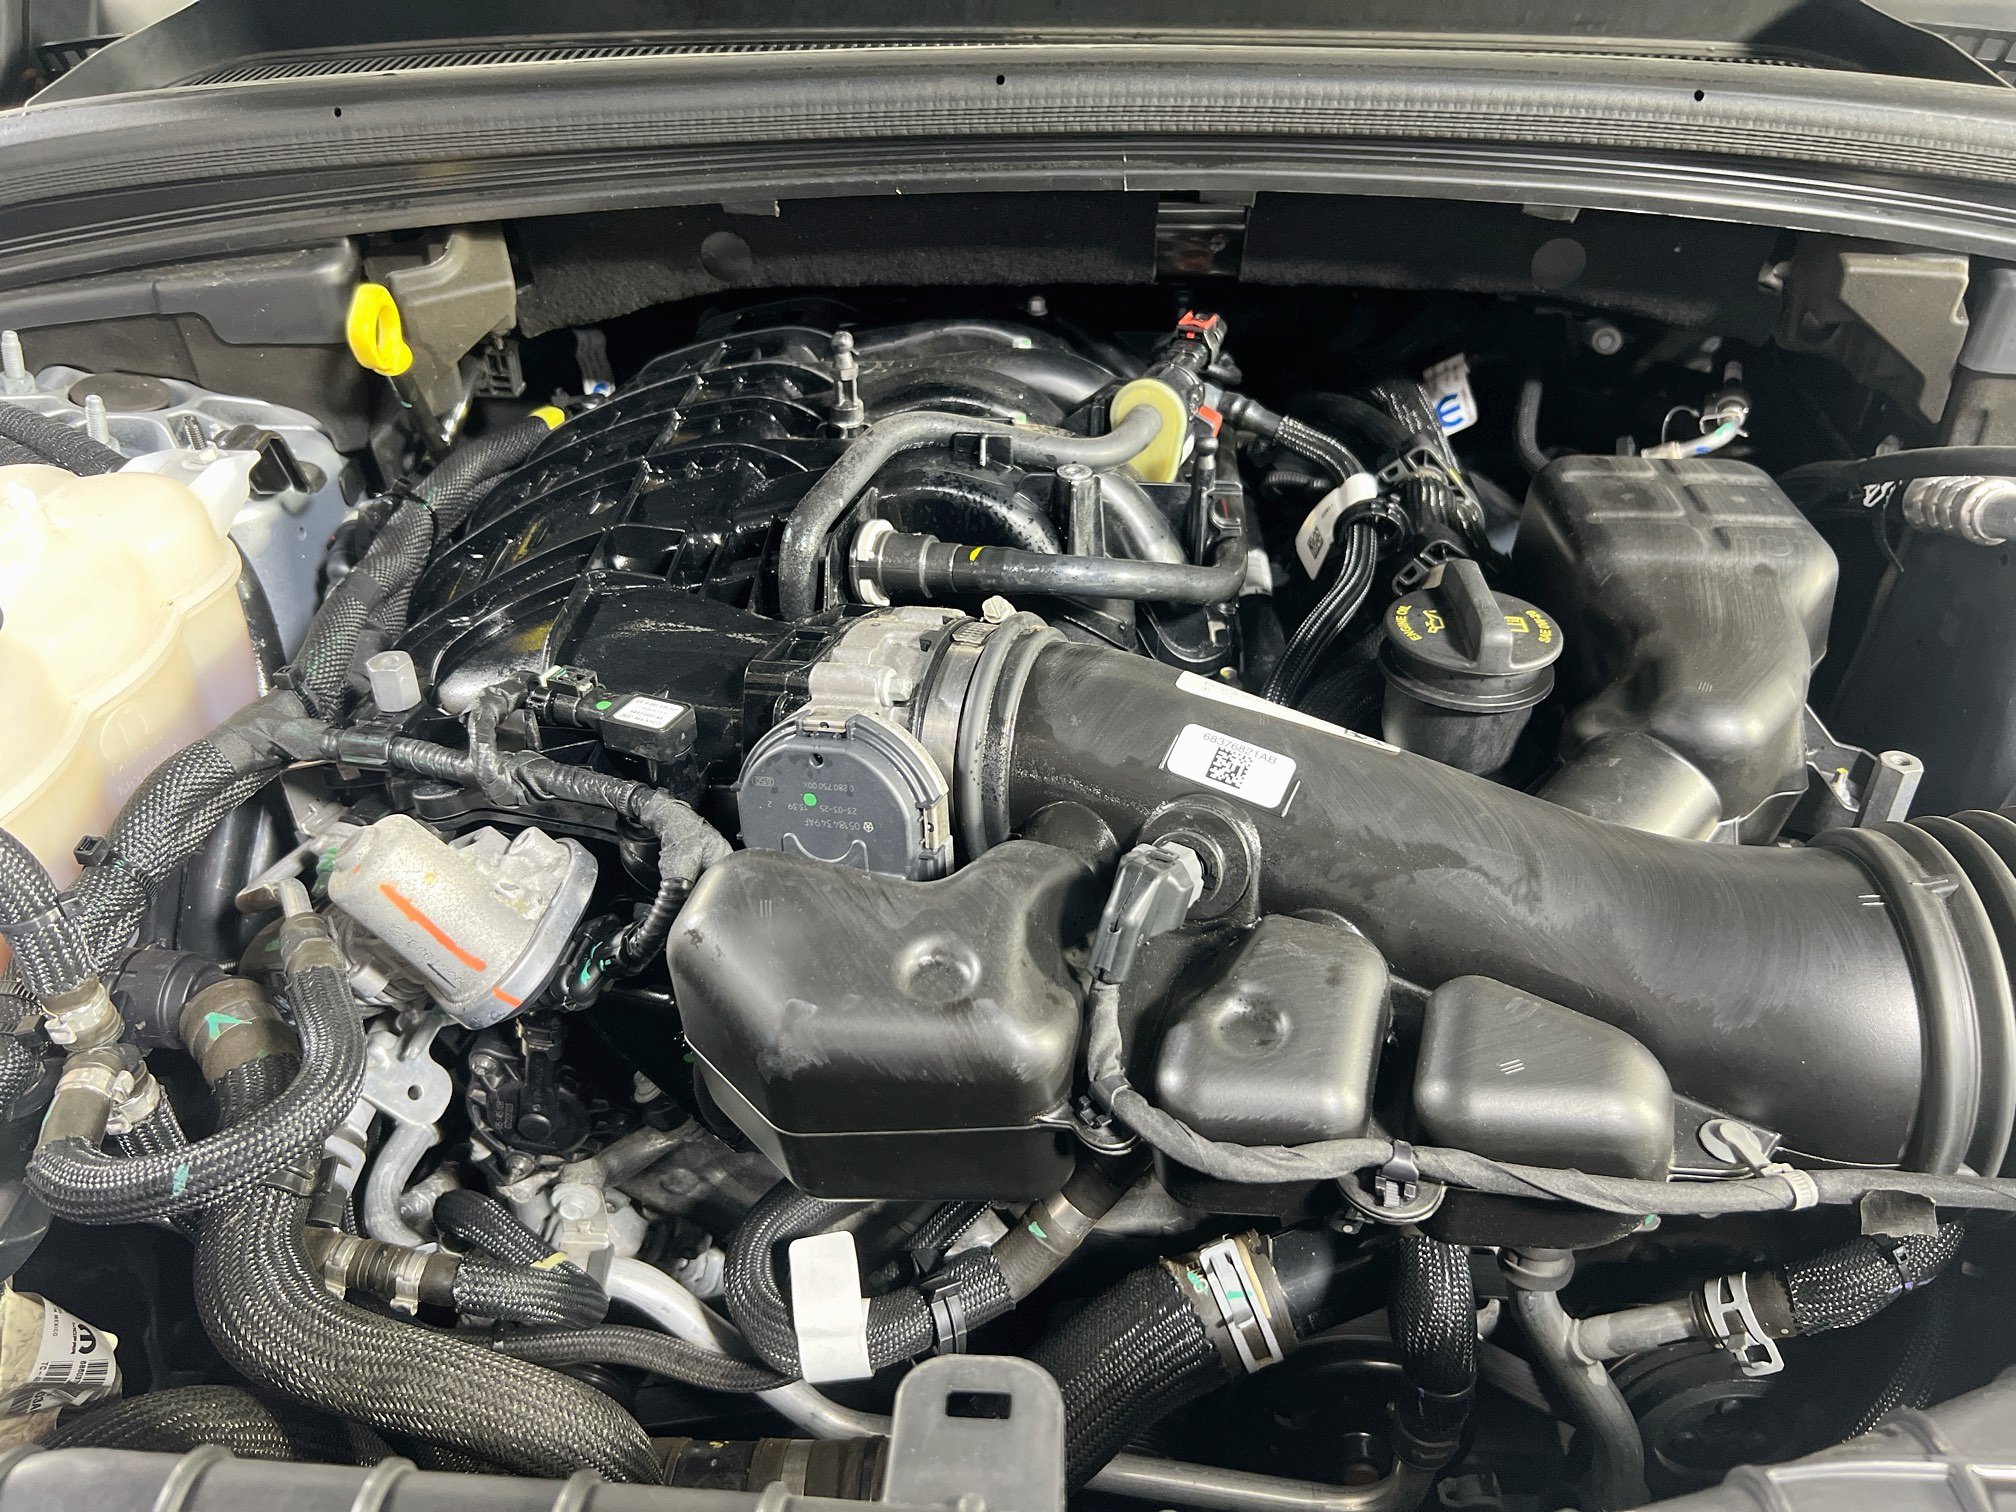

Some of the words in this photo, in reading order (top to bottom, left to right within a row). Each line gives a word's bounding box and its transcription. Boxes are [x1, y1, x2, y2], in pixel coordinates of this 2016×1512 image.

[1202, 731, 1278, 765] 68376821AB
[803, 818, 861, 831] 05184349AF
[52, 1314, 60, 1337] MEXICO
